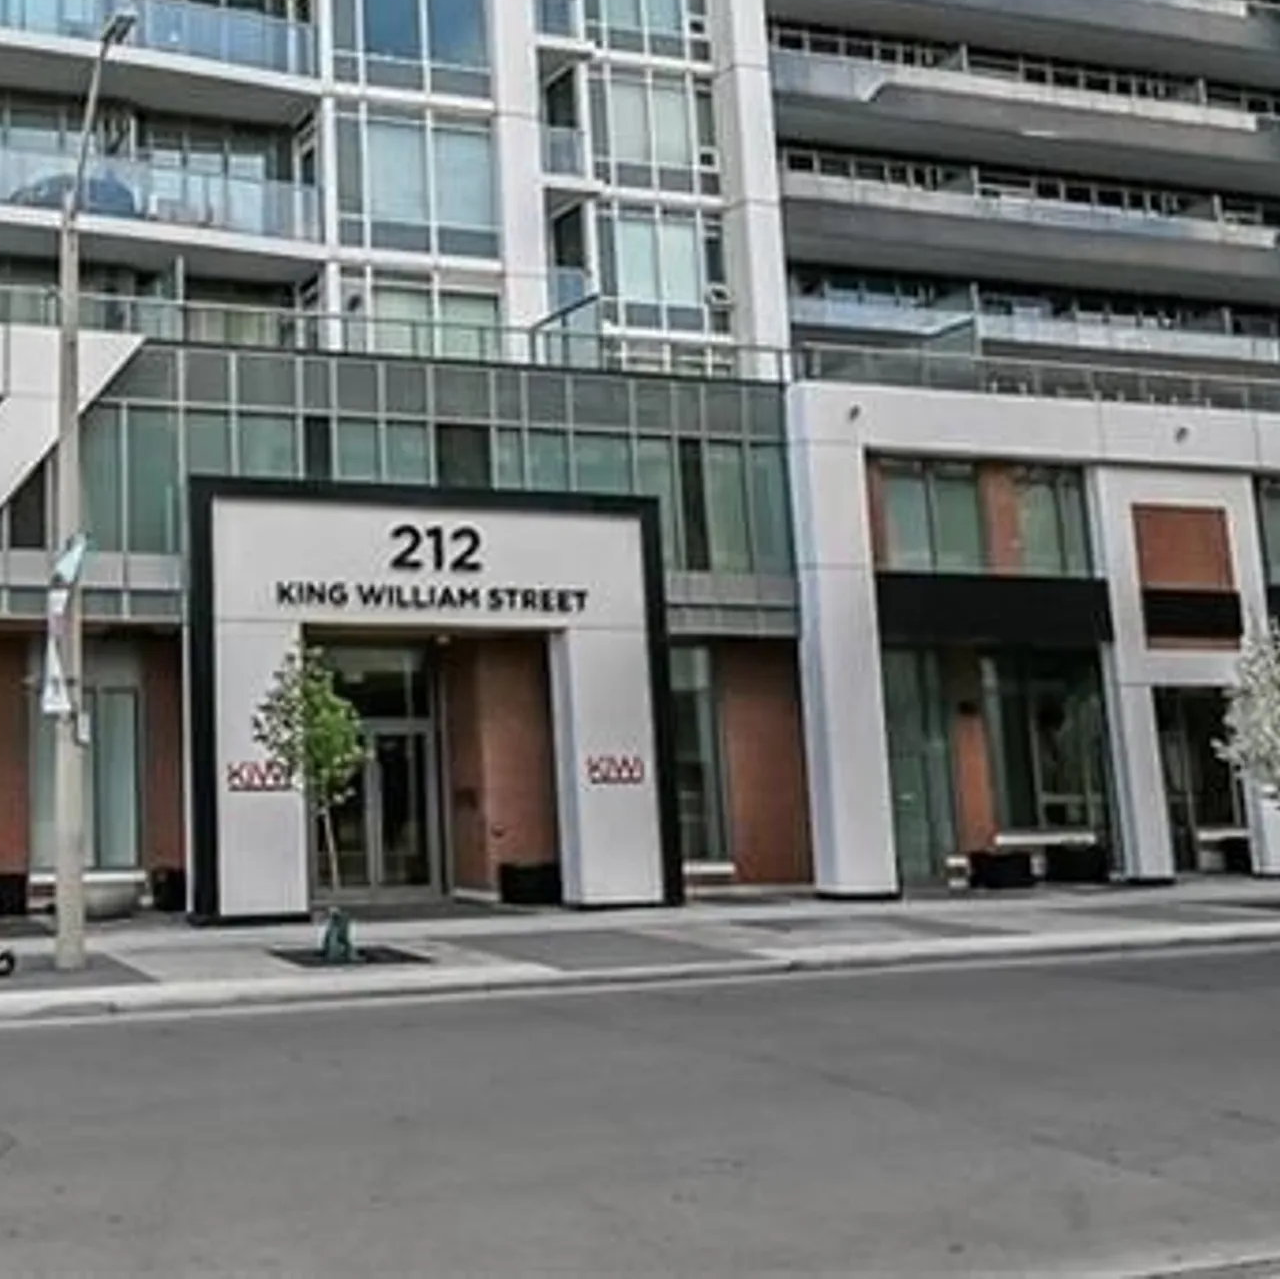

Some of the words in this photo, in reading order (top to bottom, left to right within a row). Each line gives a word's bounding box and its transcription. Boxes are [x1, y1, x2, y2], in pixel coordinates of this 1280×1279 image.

[390, 524, 482, 571] 212
[276, 581, 349, 607] KING
[356, 584, 480, 609] WILLIAM
[487, 587, 589, 612] STREET
